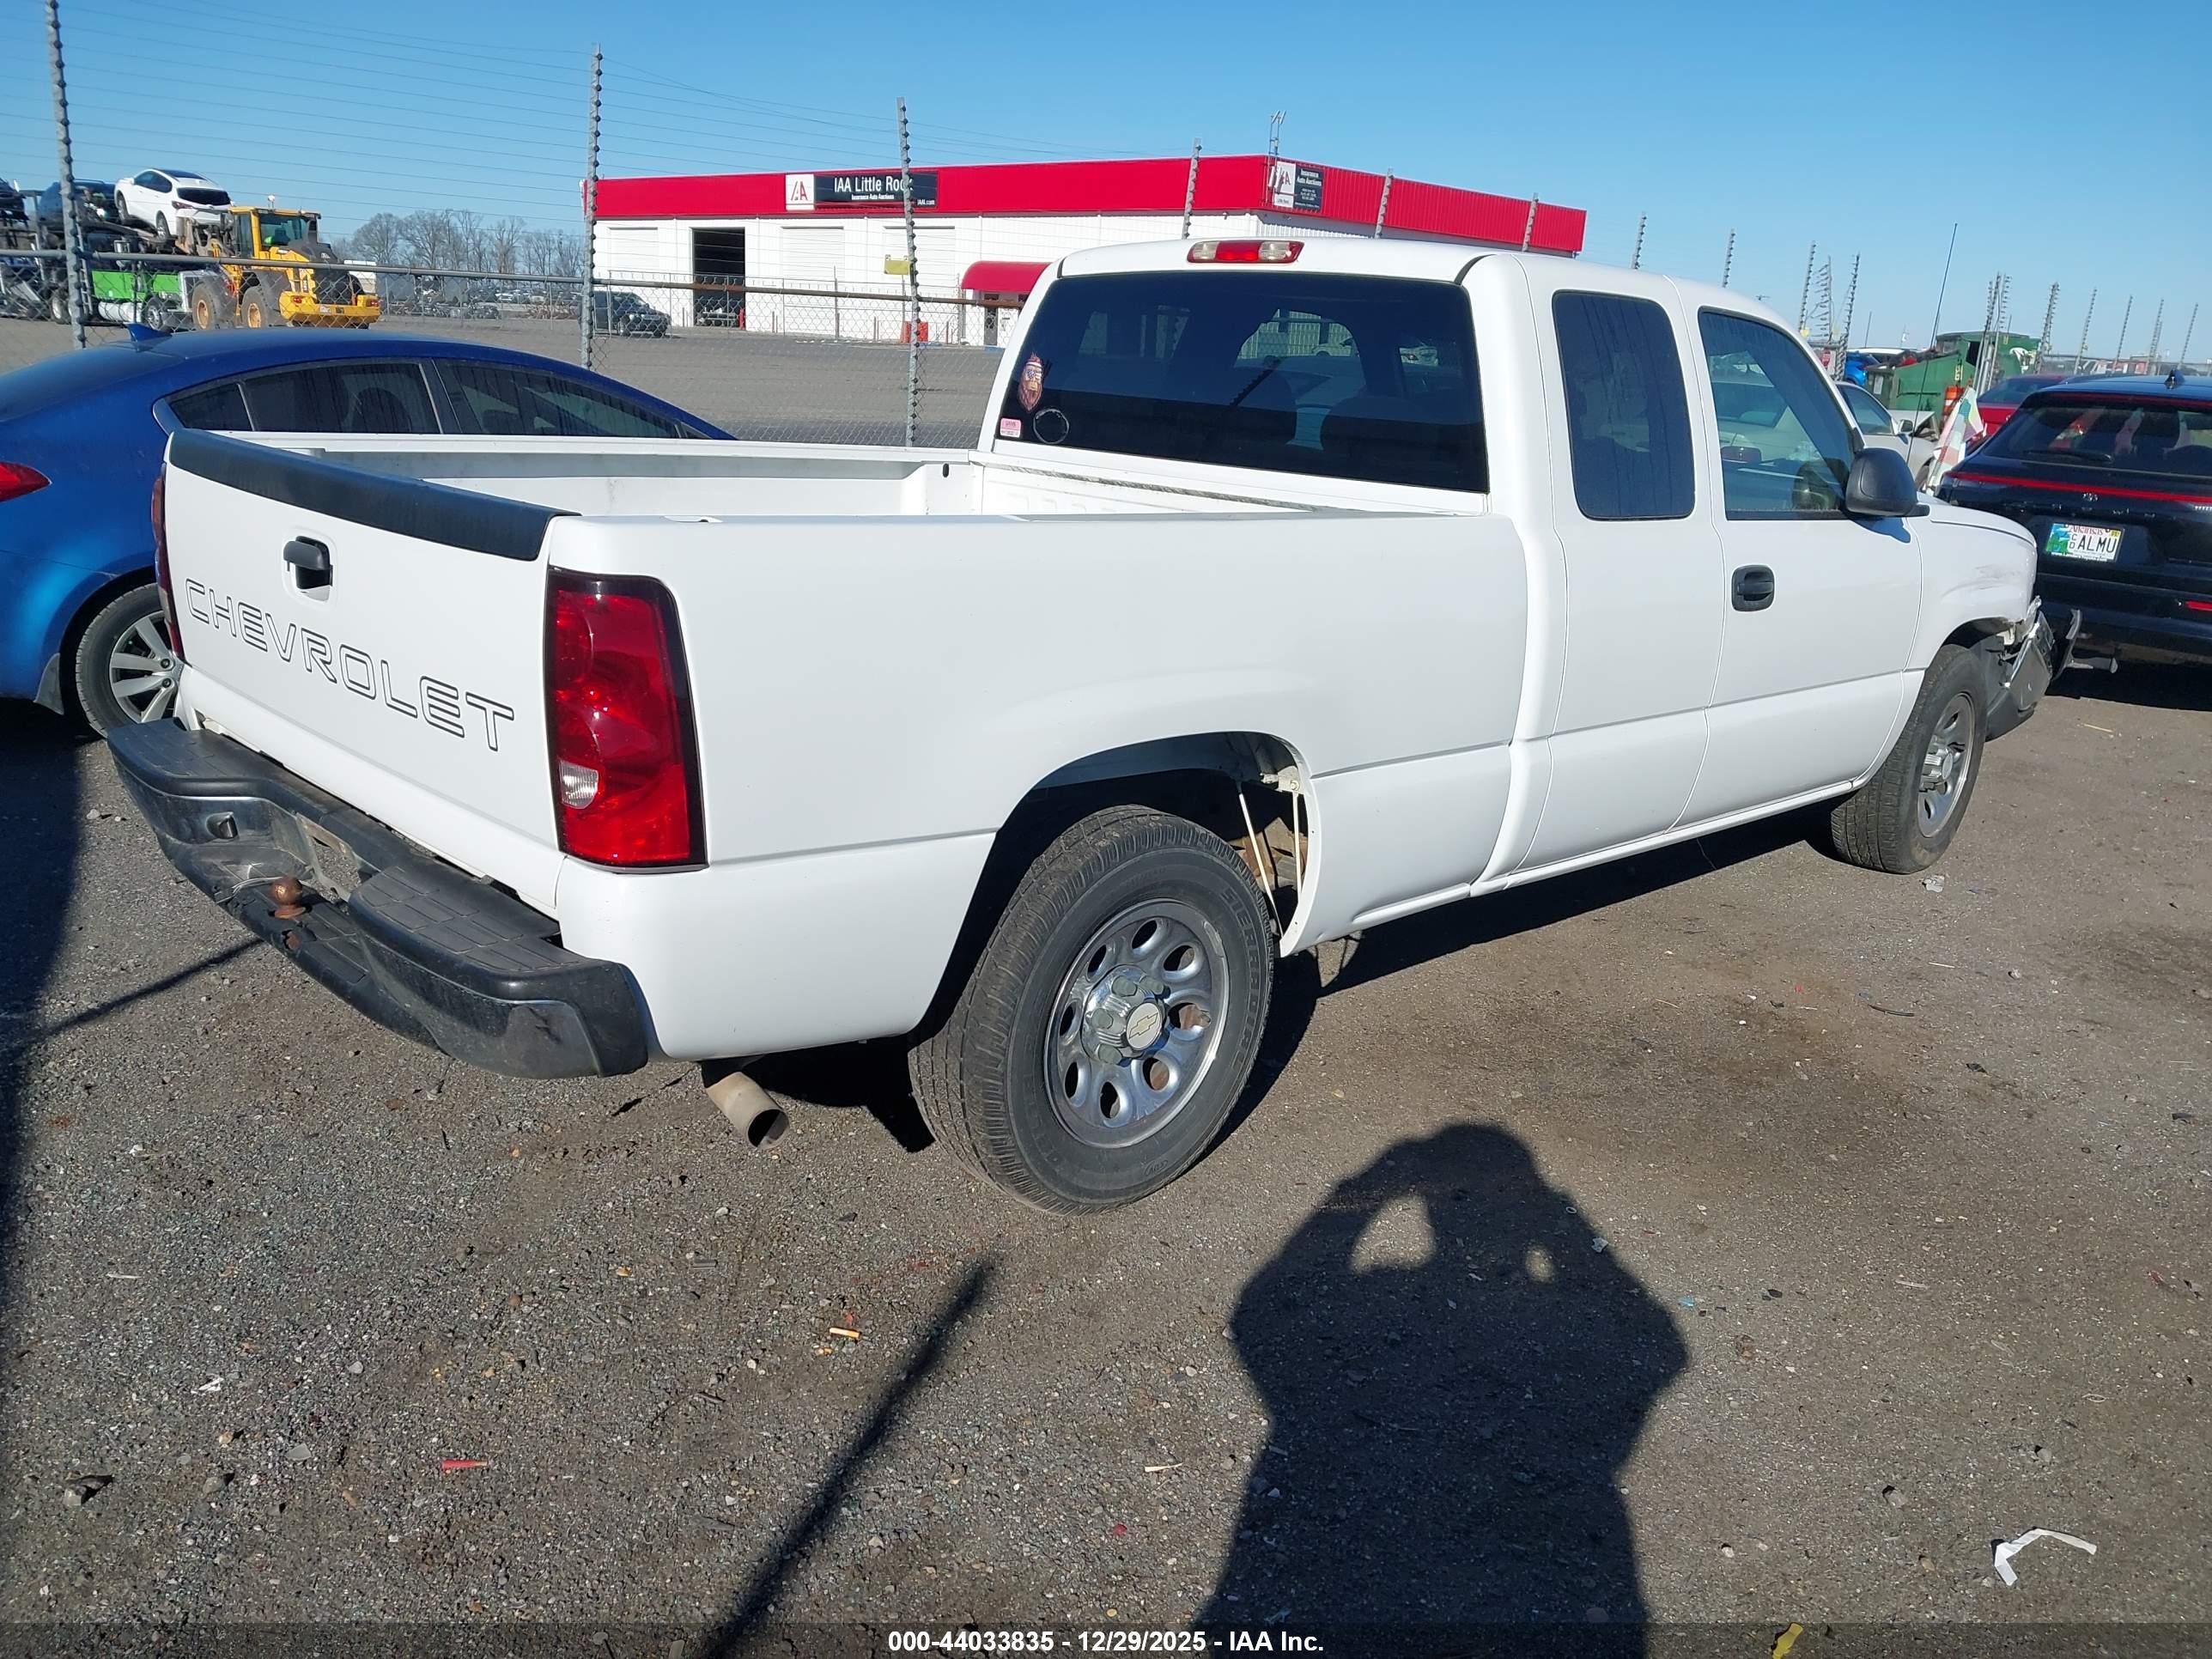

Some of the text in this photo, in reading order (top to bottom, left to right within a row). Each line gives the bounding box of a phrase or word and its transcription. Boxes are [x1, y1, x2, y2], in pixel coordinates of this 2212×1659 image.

[834, 177, 852, 192] IAA
[854, 176, 882, 192] Little
[2077, 535, 2118, 554] ALMU
[185, 577, 515, 753] CHEVROLET
